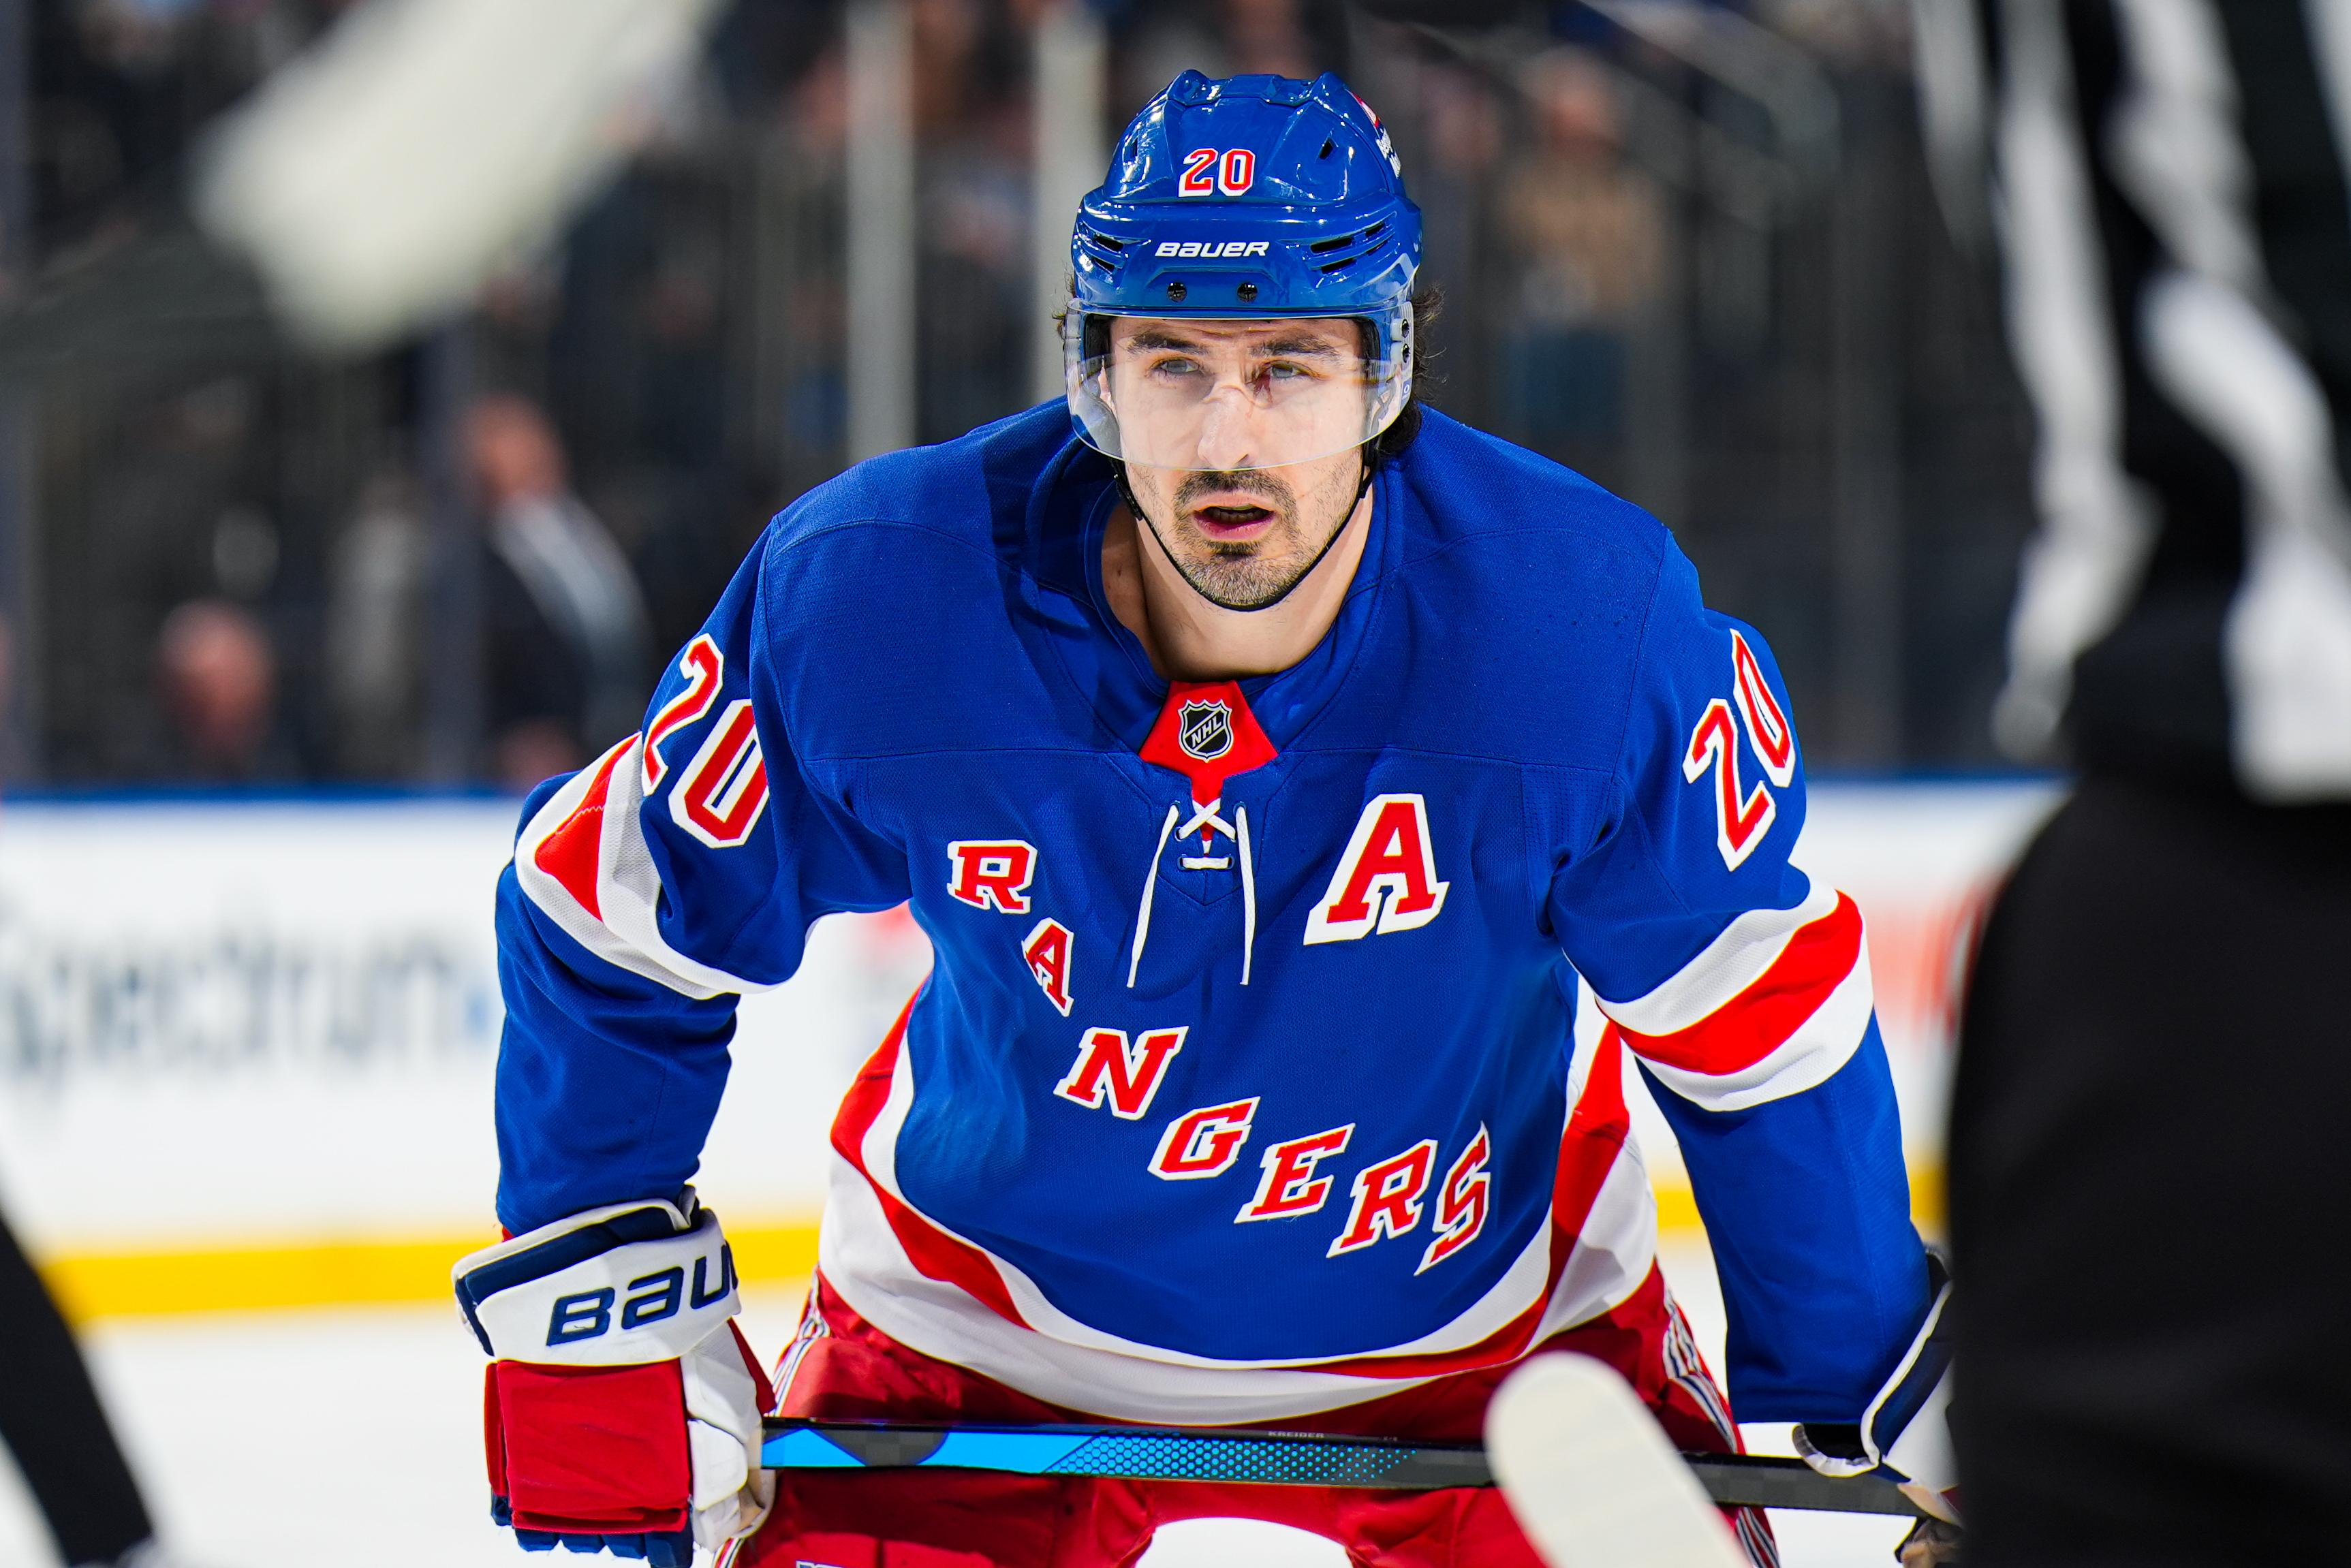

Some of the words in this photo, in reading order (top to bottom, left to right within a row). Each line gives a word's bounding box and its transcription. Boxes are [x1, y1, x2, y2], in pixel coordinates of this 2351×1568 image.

[1178, 147, 1256, 197] 20
[641, 632, 770, 849] 20
[1191, 715, 1222, 748] NHL
[1682, 627, 1796, 872] 20
[1303, 793, 1450, 945] A
[947, 839, 1491, 1276] RANGERS
[546, 1239, 738, 1347] BAU
[1267, 1430, 1325, 1439] KREIDER
